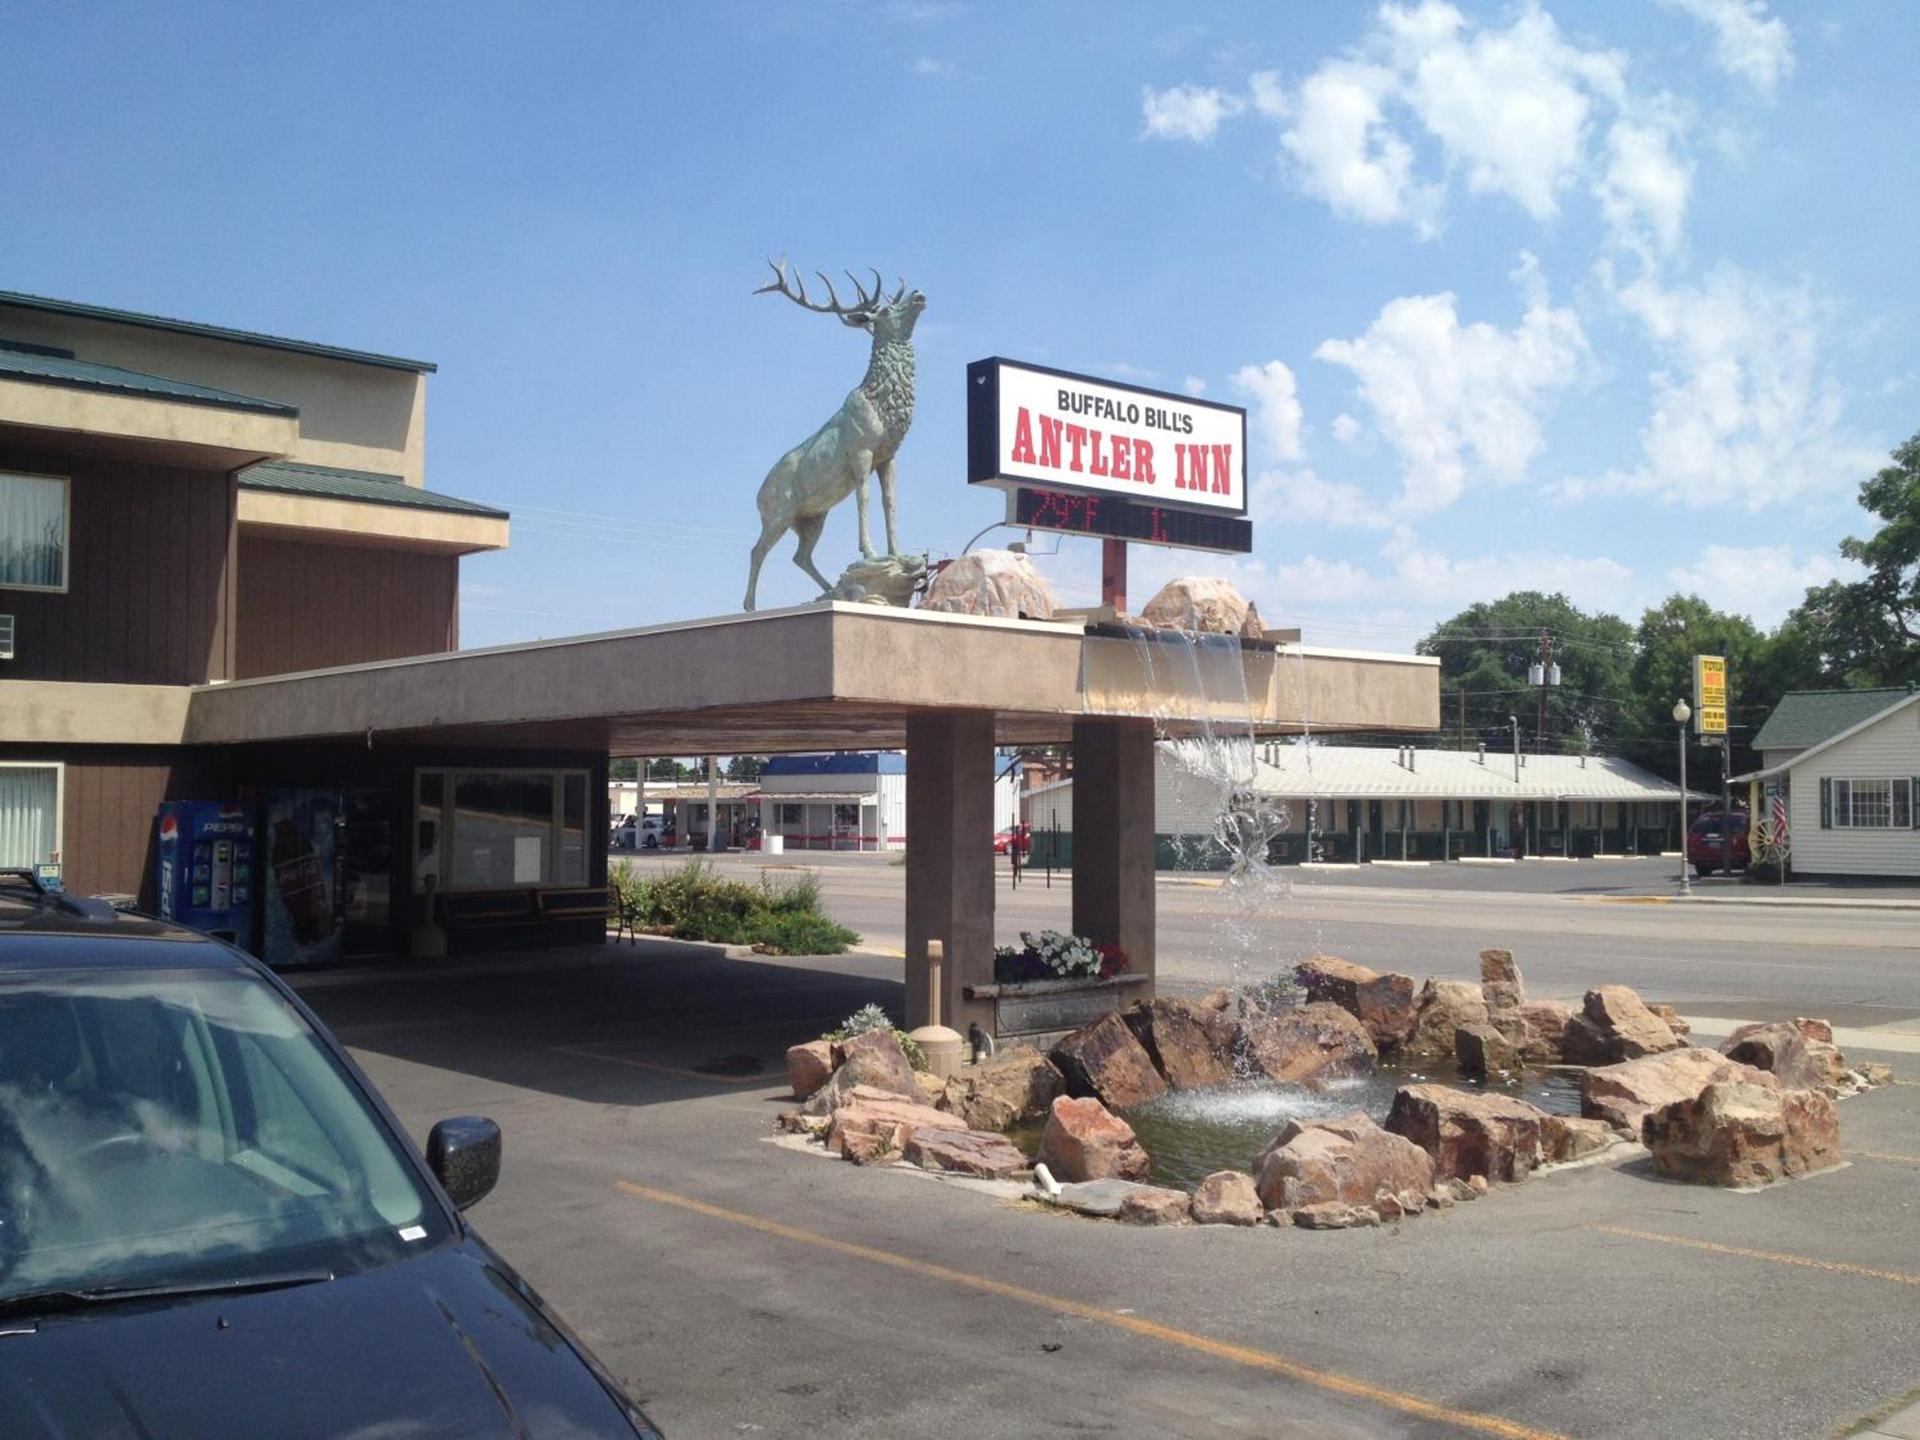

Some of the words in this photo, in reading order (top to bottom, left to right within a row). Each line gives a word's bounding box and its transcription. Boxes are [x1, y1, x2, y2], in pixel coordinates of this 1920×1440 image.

[1057, 389, 1140, 425] BUFFALO
[1145, 406, 1194, 435] BILL'S
[1011, 406, 1156, 485] ANTLER
[1174, 443, 1232, 496] INN
